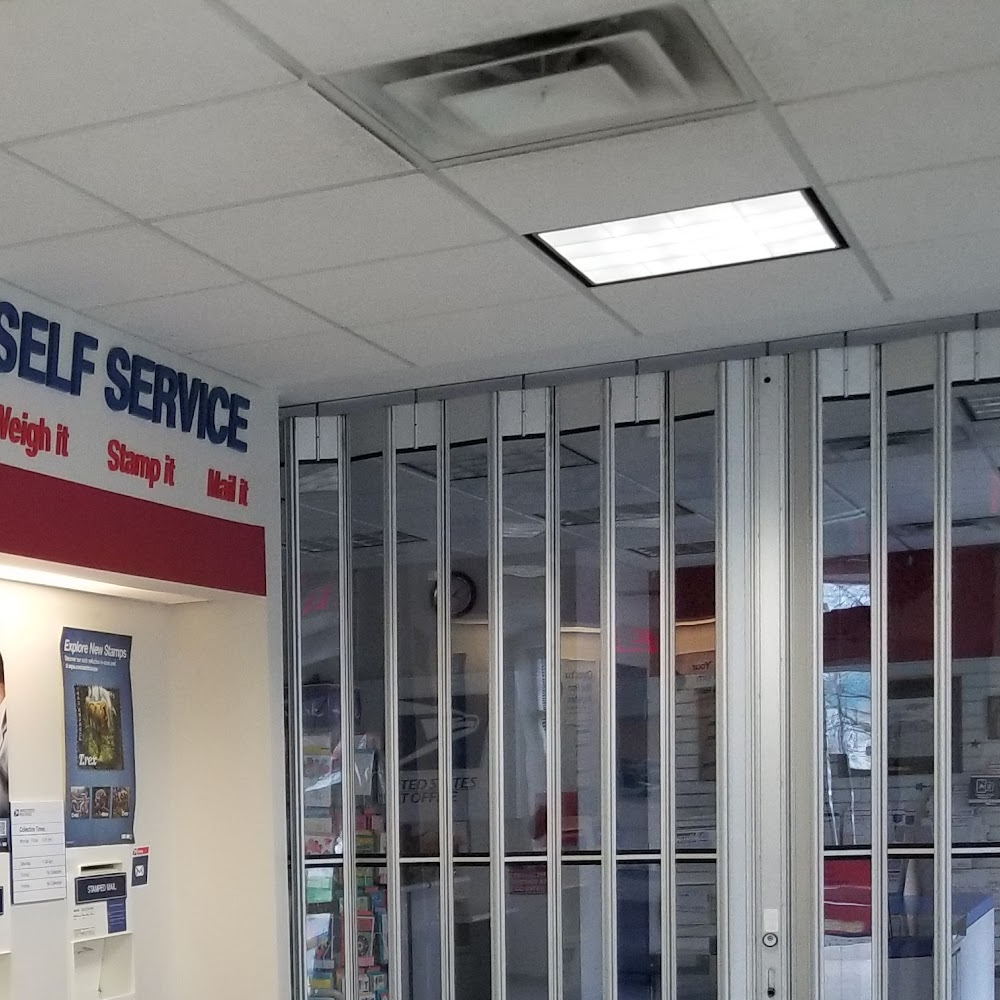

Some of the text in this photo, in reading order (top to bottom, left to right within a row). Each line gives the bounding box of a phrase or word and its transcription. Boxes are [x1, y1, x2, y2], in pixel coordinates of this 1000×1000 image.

[104, 347, 250, 453] SERVICE
[56, 423, 70, 457] it
[107, 439, 161, 488] Stamp
[163, 455, 175, 486] it
[206, 468, 236, 502] Mail
[238, 477, 249, 506] it
[64, 639, 88, 655] Explore
[89, 642, 103, 655] New
[104, 644, 127, 660] Stamps
